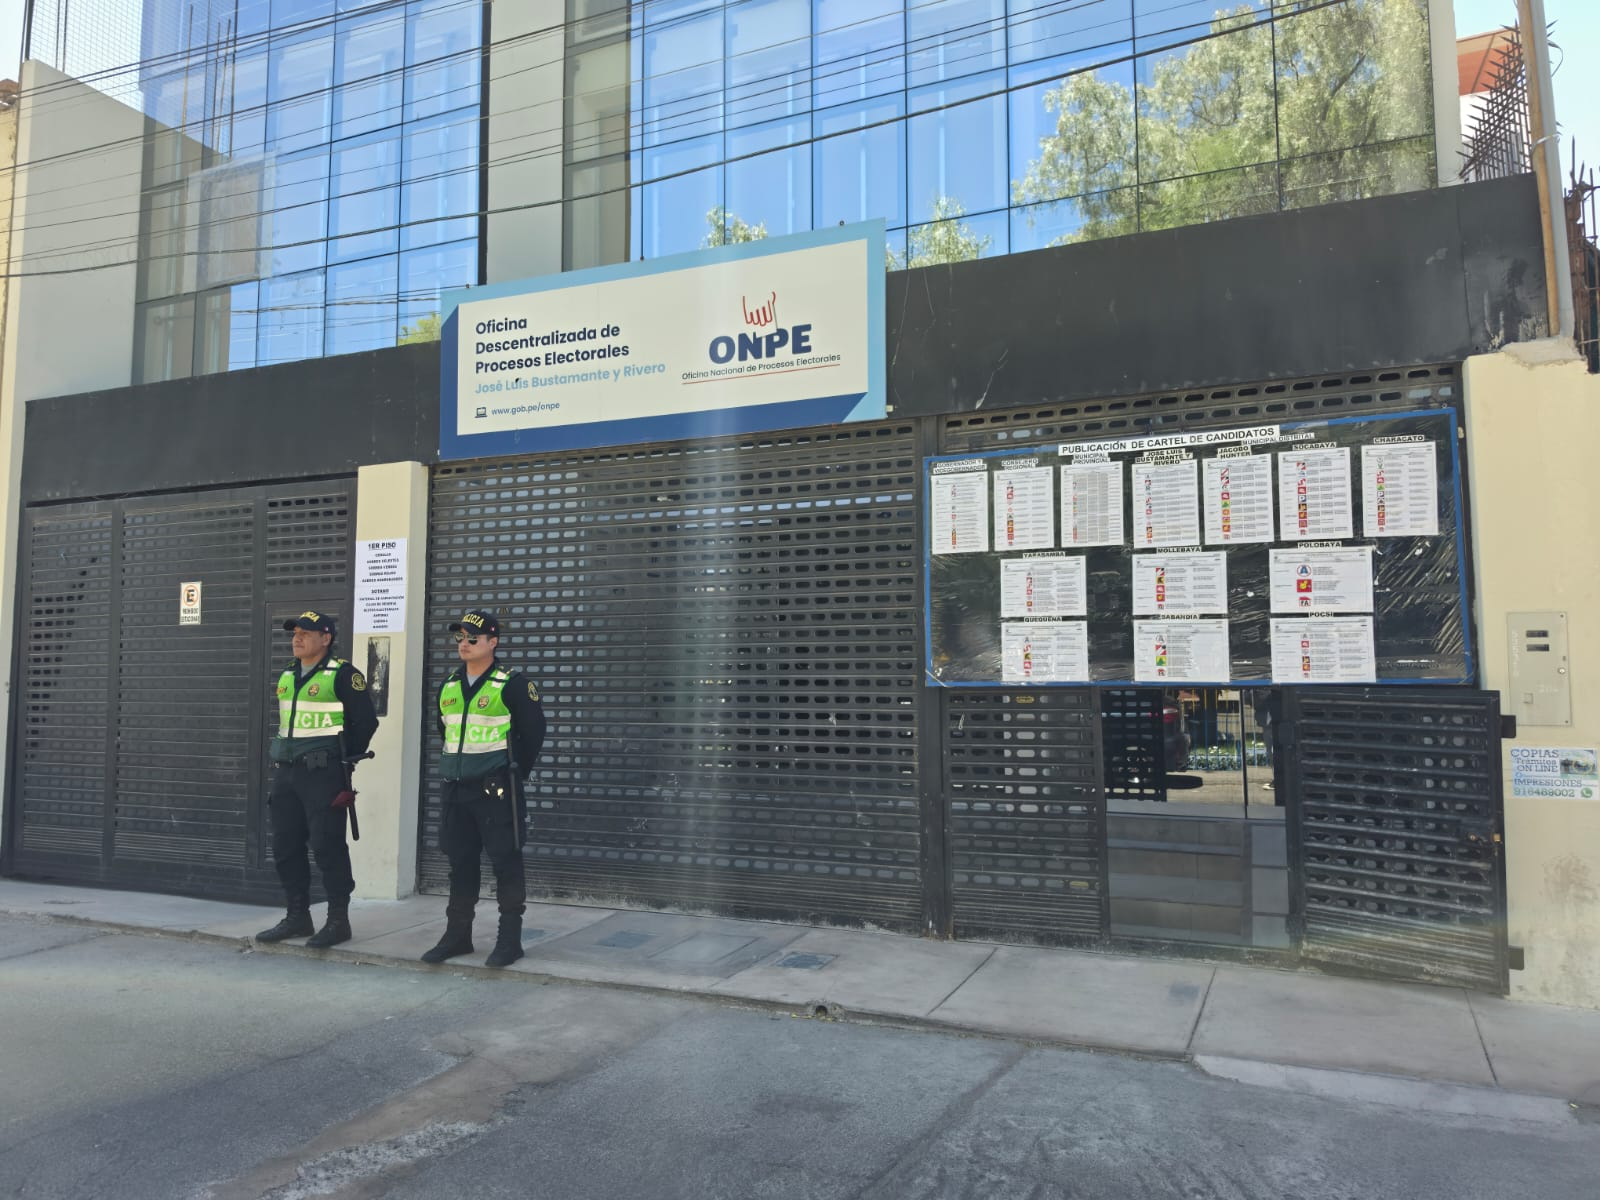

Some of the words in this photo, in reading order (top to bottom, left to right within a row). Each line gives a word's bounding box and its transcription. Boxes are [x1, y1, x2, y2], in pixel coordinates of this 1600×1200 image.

[475, 317, 528, 335] Oficina
[475, 326, 597, 355] Descentralizada
[600, 323, 621, 338] de
[708, 323, 812, 365] ONPE
[475, 354, 541, 374] Procesos
[545, 344, 630, 367] Electorales
[681, 369, 709, 380] Oficina
[710, 365, 745, 377] Nacional
[746, 363, 757, 373] de
[758, 360, 795, 371] Procesos
[796, 354, 841, 366] Electorales
[474, 379, 503, 394] José
[505, 377, 529, 391] Luis
[531, 369, 610, 388] Bustamante
[612, 368, 621, 382] y
[623, 361, 666, 378] Rivero
[491, 401, 560, 416] www.gob.pe/onpe
[1062, 440, 1127, 454] PUBLICACIÓN
[1131, 440, 1145, 449] DE
[1147, 436, 1187, 447] CARTEL
[1189, 435, 1203, 444] DE
[1206, 427, 1275, 443] CANDIDATOS
[1510, 748, 1560, 758] COPIAS
[1514, 778, 1582, 787] IMPRESIONES
